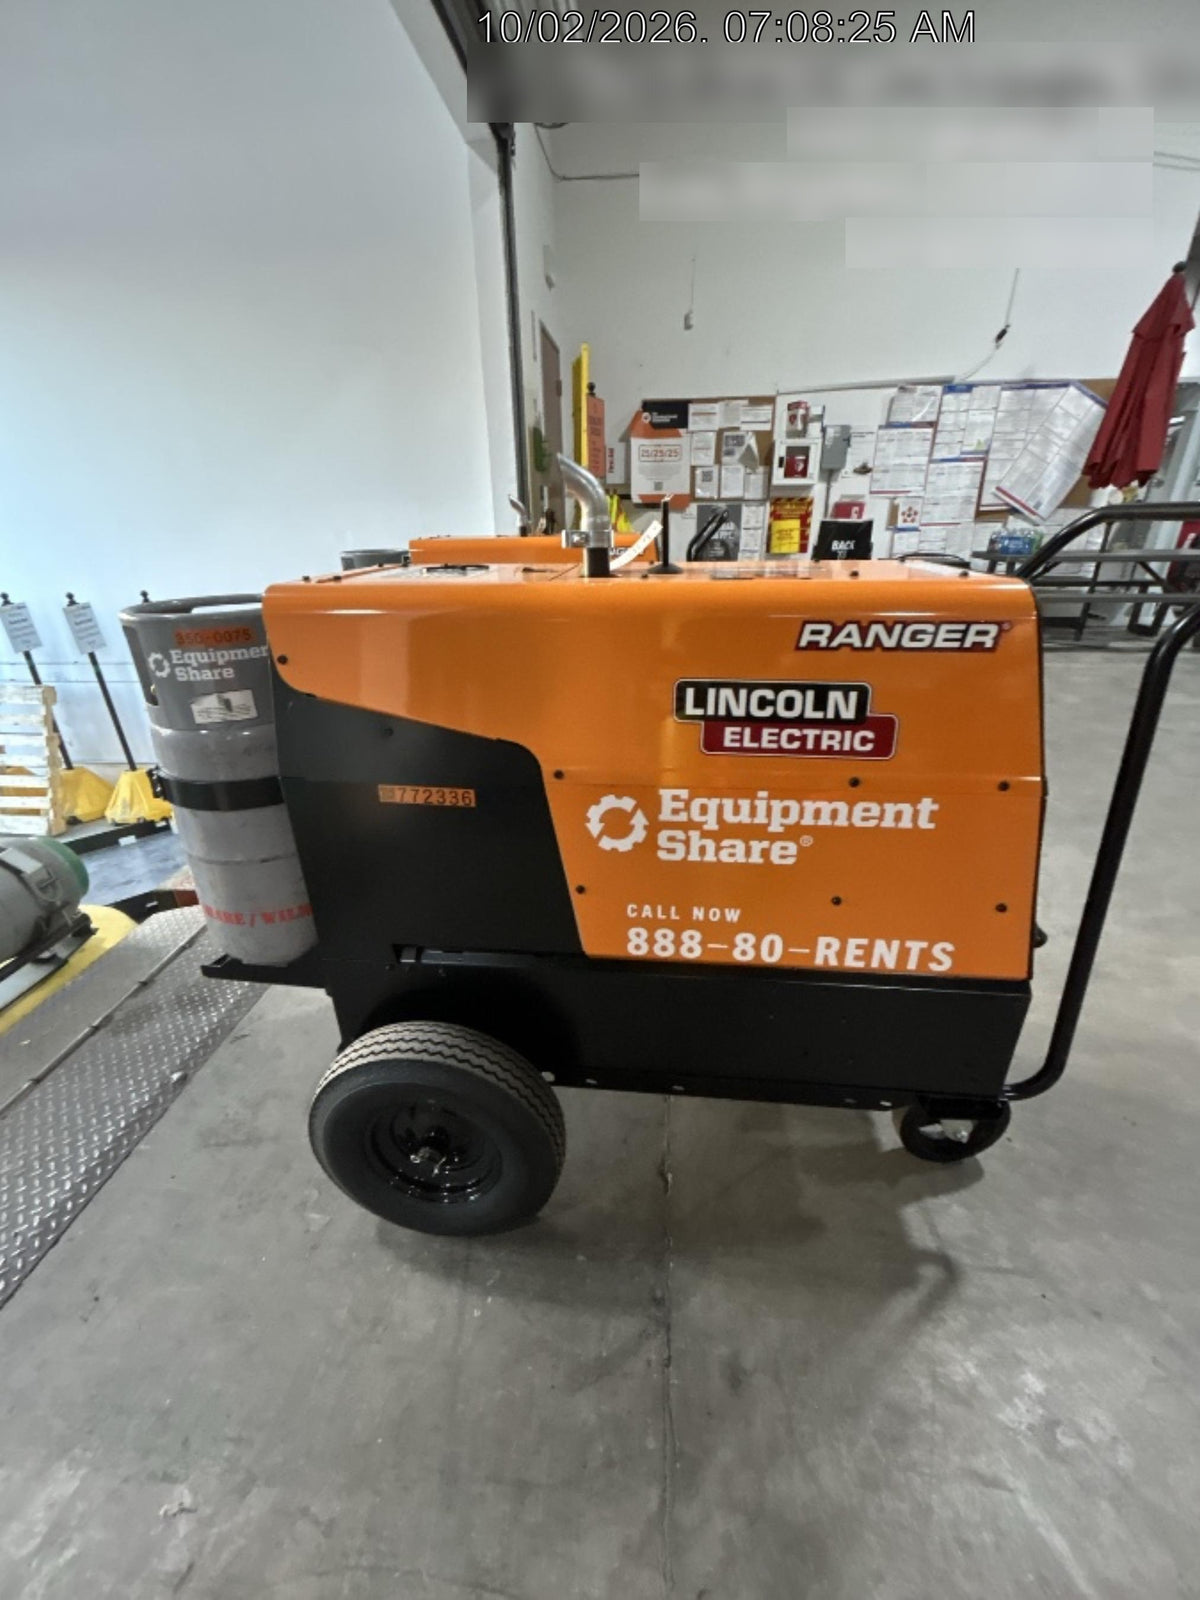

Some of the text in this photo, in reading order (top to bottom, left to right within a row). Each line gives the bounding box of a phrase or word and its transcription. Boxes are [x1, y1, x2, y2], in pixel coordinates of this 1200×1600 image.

[174, 665, 235, 682] Share
[685, 687, 858, 720] LINCOLN
[723, 726, 875, 752] ELECTRIC
[398, 787, 473, 807] 772336
[658, 789, 940, 832] Equipment
[626, 904, 742, 923] CALL NOW
